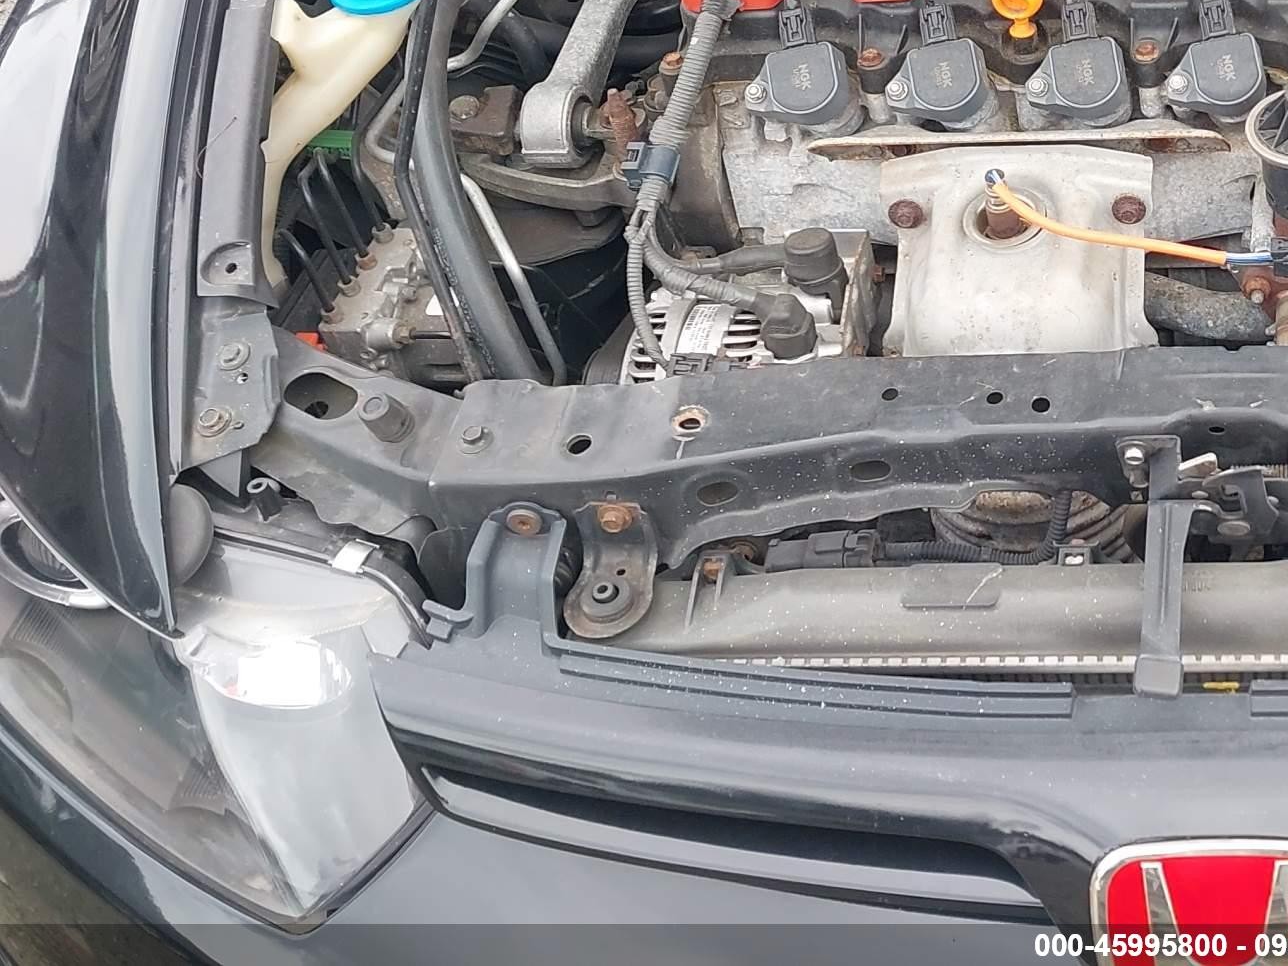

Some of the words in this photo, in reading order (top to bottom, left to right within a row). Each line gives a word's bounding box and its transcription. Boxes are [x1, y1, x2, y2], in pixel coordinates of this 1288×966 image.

[799, 64, 811, 90] NGK
[939, 62, 952, 88] NGK
[1080, 59, 1095, 84] NGK
[1222, 54, 1236, 81] NGK
